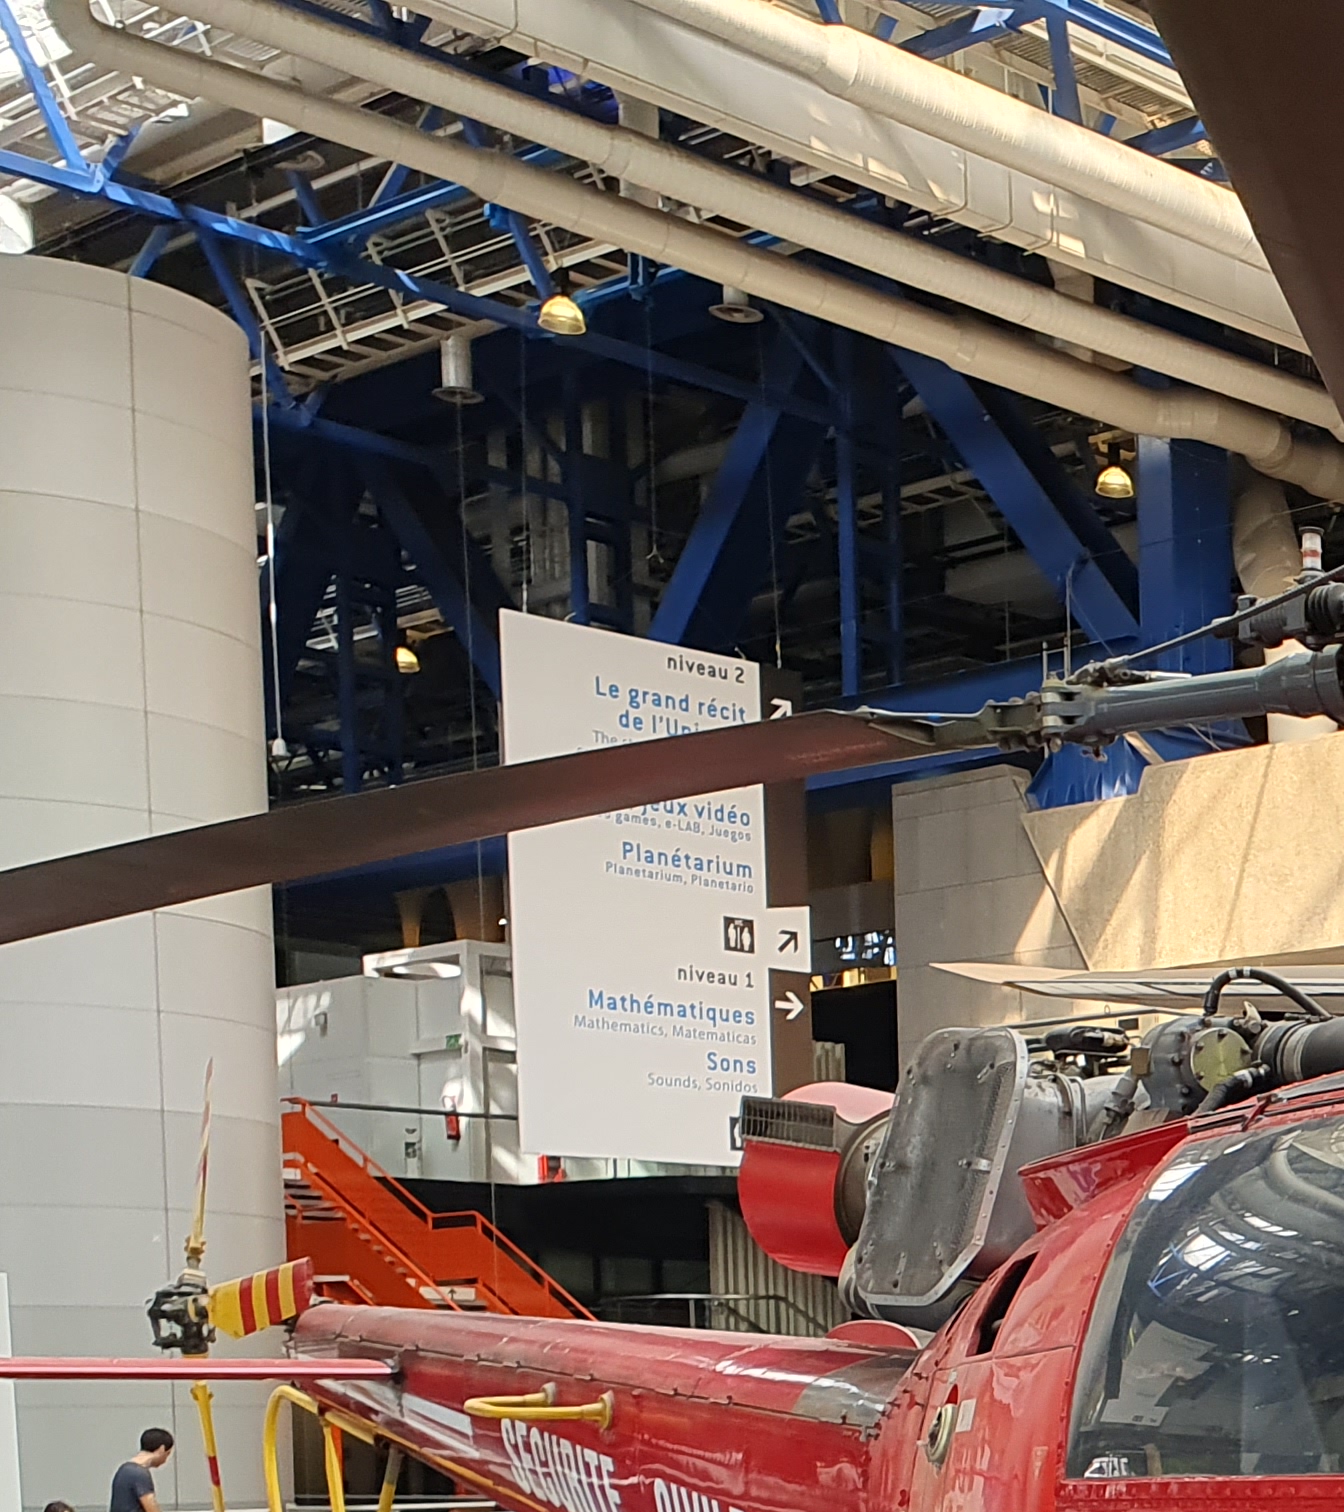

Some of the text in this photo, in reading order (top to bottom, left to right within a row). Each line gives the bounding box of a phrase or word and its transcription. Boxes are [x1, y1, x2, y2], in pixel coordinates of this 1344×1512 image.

[667, 654, 745, 683] niveau 2
[595, 676, 746, 722] Le grand récit
[618, 710, 643, 731] de
[694, 801, 751, 827] vidéo
[709, 824, 752, 843] Juegos
[622, 841, 753, 879] Planétarium
[605, 861, 754, 894] Planetarium, Planetario
[677, 965, 754, 988] niveau 1
[588, 989, 756, 1028] Mathématiques
[574, 1015, 757, 1046] Mathematics, Matematicas
[707, 1051, 757, 1074] Sons
[647, 1072, 758, 1094] Sounds, Sonidos
